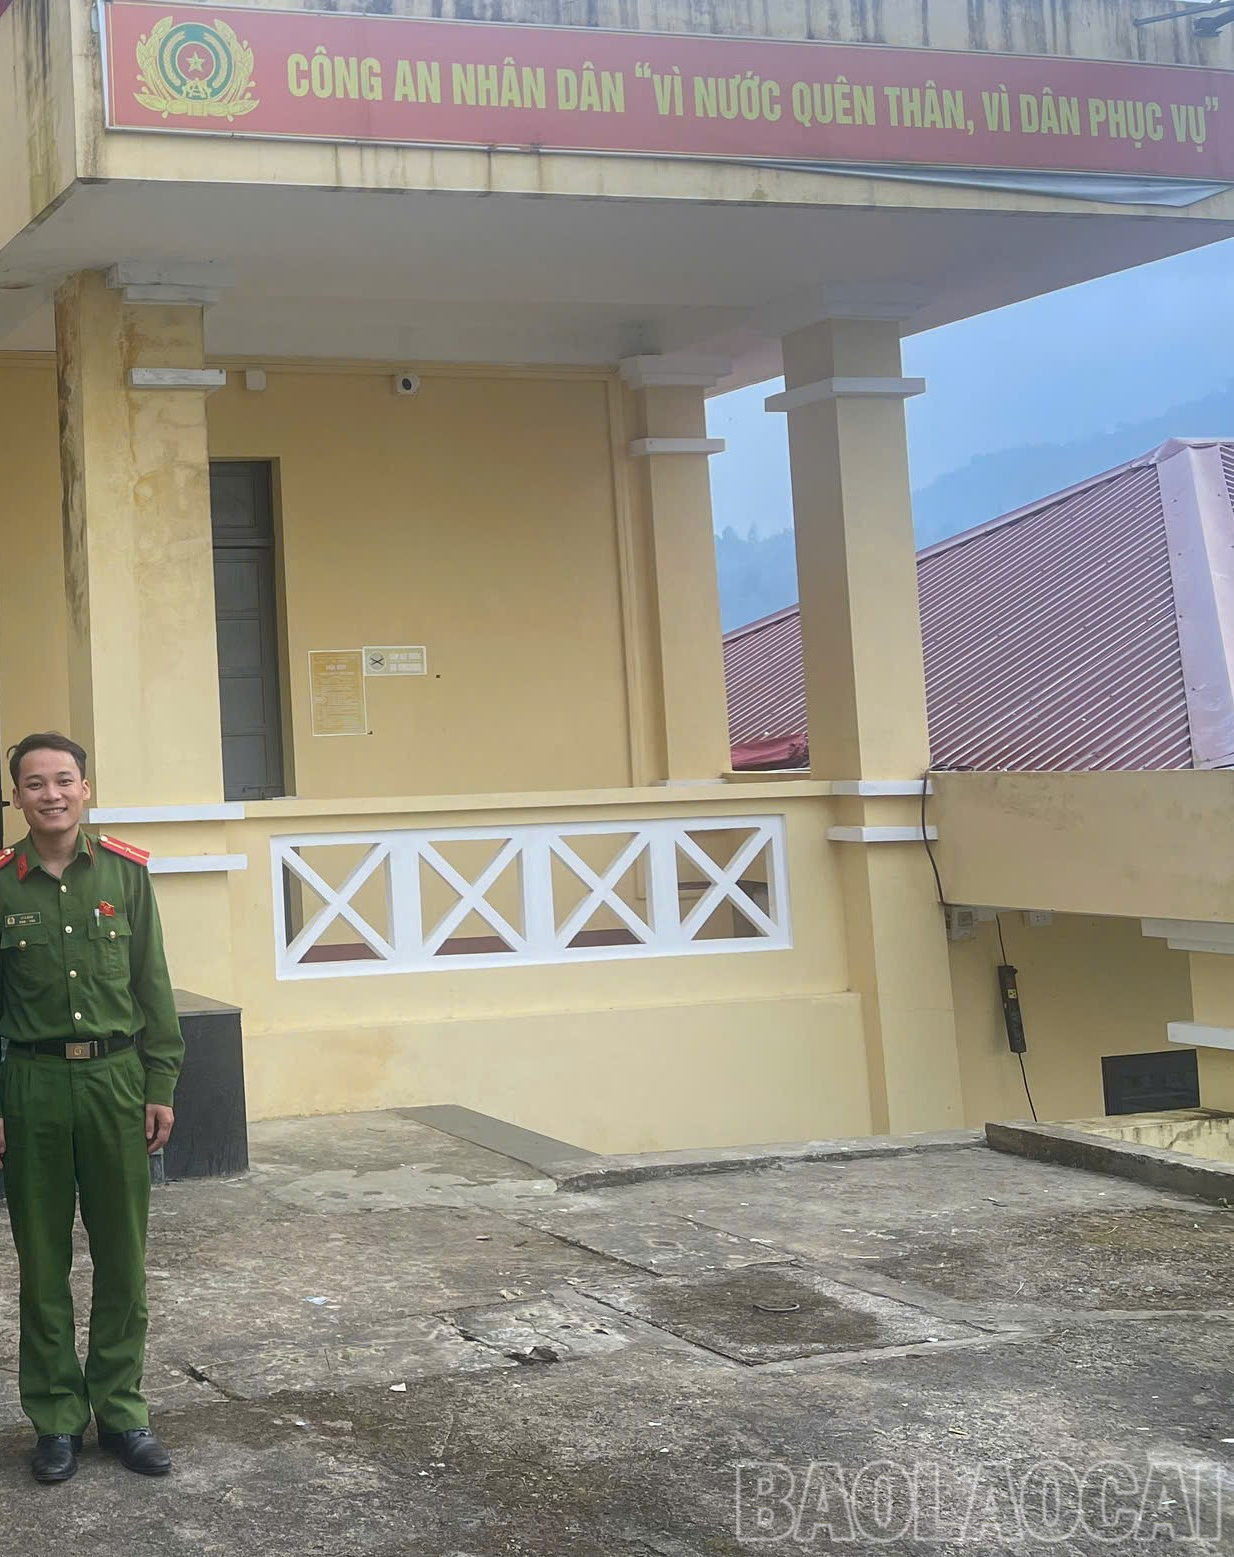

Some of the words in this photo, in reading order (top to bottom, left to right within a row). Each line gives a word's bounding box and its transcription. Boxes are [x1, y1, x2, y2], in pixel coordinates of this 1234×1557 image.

[287, 46, 383, 100] CÔNG
[394, 60, 442, 104] AN
[452, 56, 546, 109] NHÂN
[557, 61, 625, 113] DÂN
[693, 71, 781, 122] NƯỚC
[792, 75, 876, 128] QUÊN
[883, 80, 974, 136] THÂN,
[981, 83, 1012, 133] VÌ
[1019, 86, 1081, 136] DÂN
[1088, 98, 1164, 149] PHỤC
